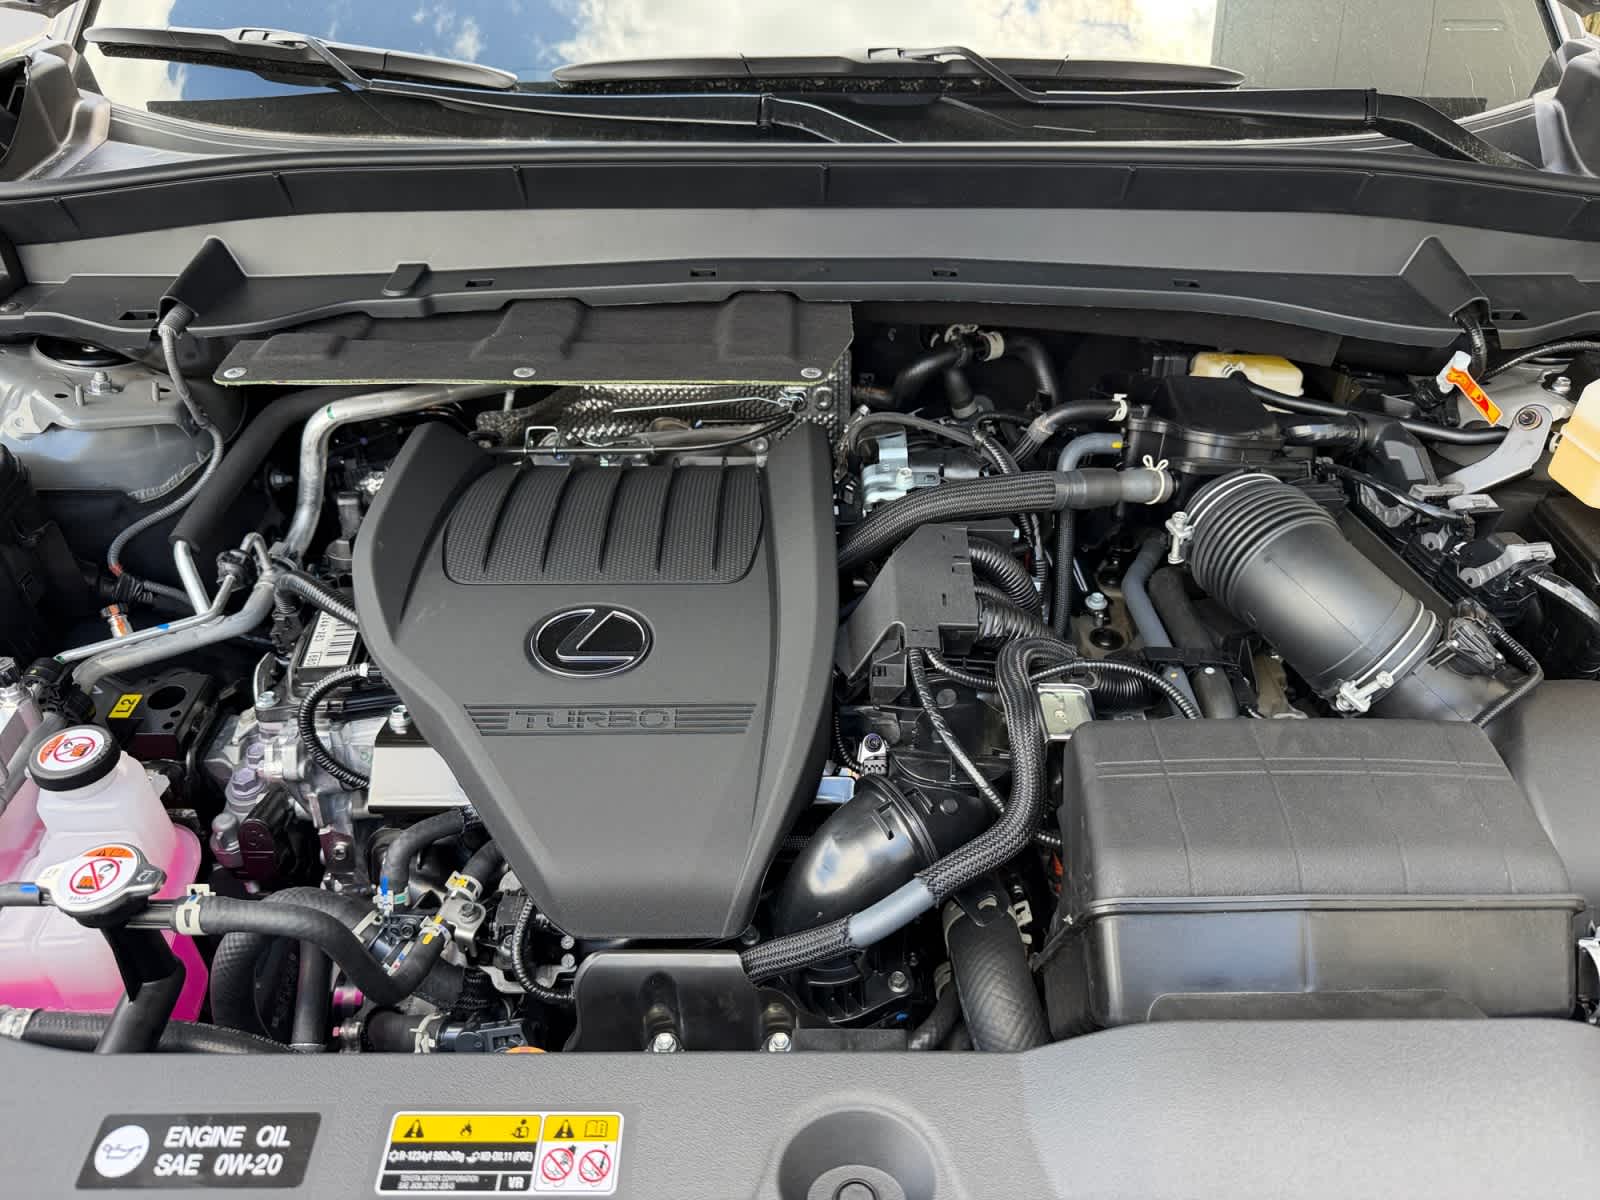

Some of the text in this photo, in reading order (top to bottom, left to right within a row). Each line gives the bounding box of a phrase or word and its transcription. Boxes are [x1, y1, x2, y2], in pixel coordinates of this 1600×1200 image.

[115, 698, 137, 713] L2
[515, 709, 671, 729] TURBO
[163, 1125, 291, 1148] ENGINE OIL
[153, 1153, 283, 1176] SAE 0W-20
[508, 1176, 525, 1189] VR
